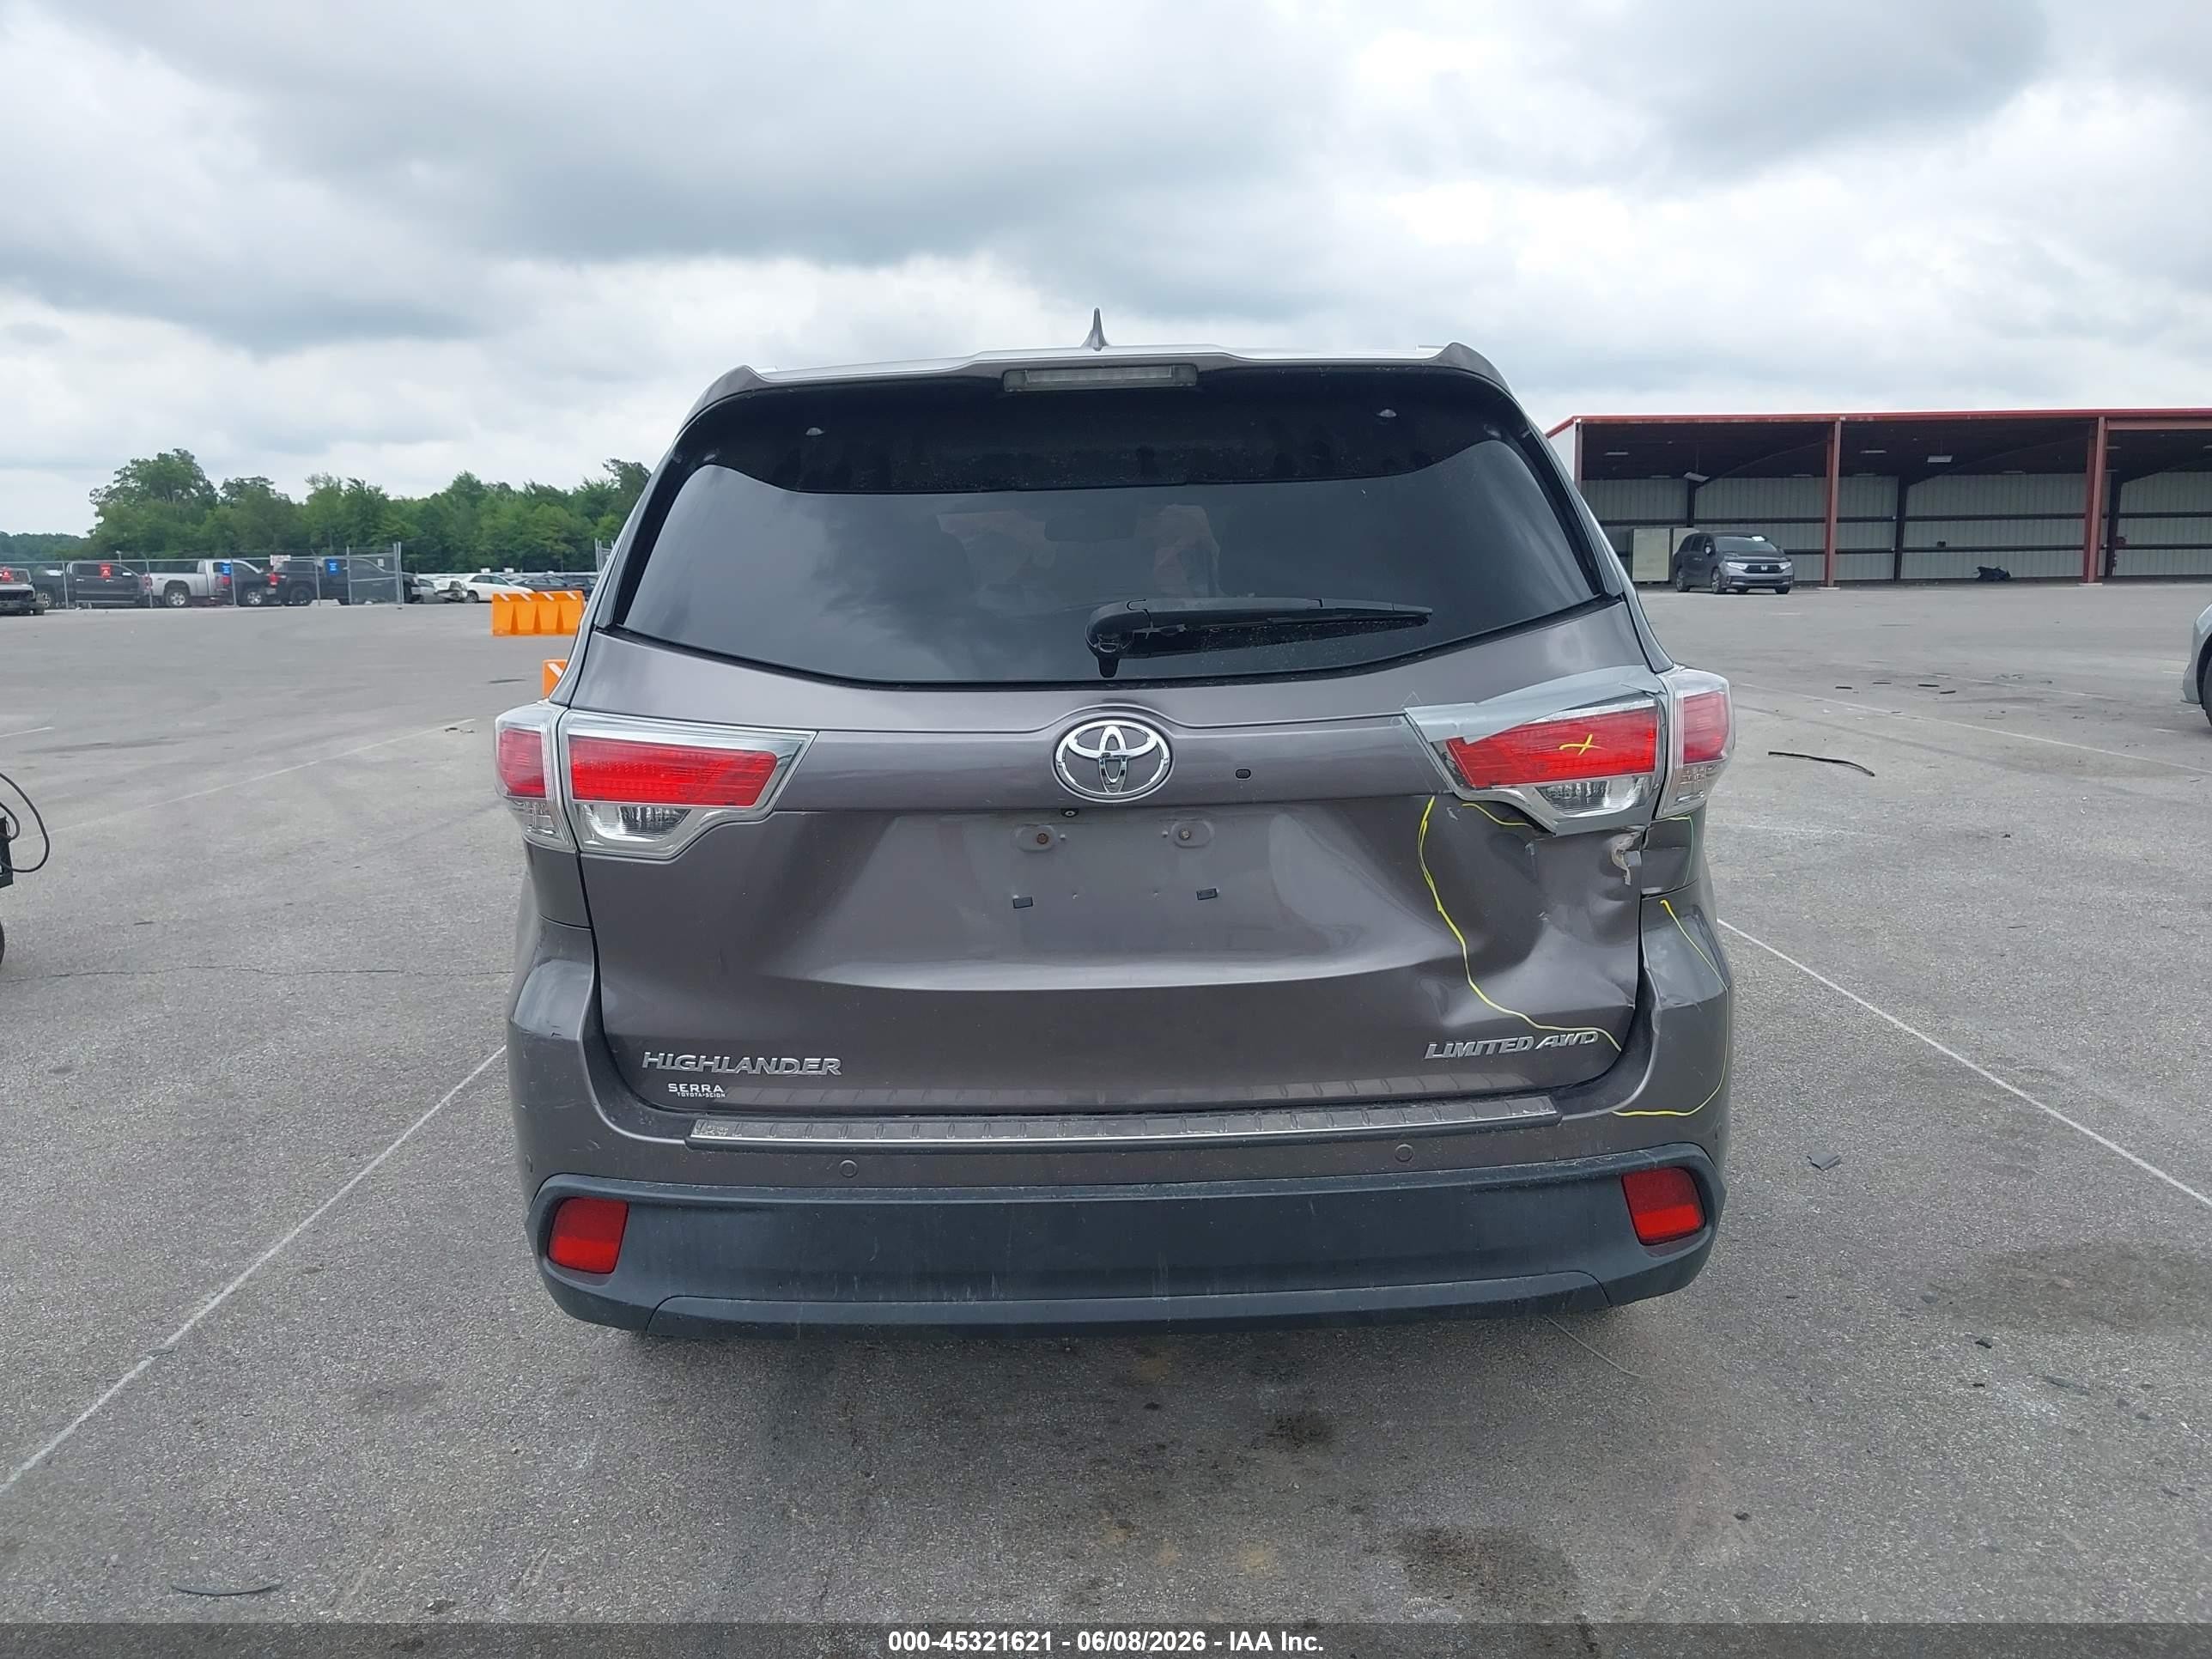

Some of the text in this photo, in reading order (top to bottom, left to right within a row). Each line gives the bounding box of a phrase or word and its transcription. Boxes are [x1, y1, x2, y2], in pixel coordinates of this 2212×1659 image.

[1424, 1030, 1599, 1060] LIMITED AWD
[641, 1051, 842, 1076] HIGHLANDER
[668, 1083, 725, 1093] SERRA
